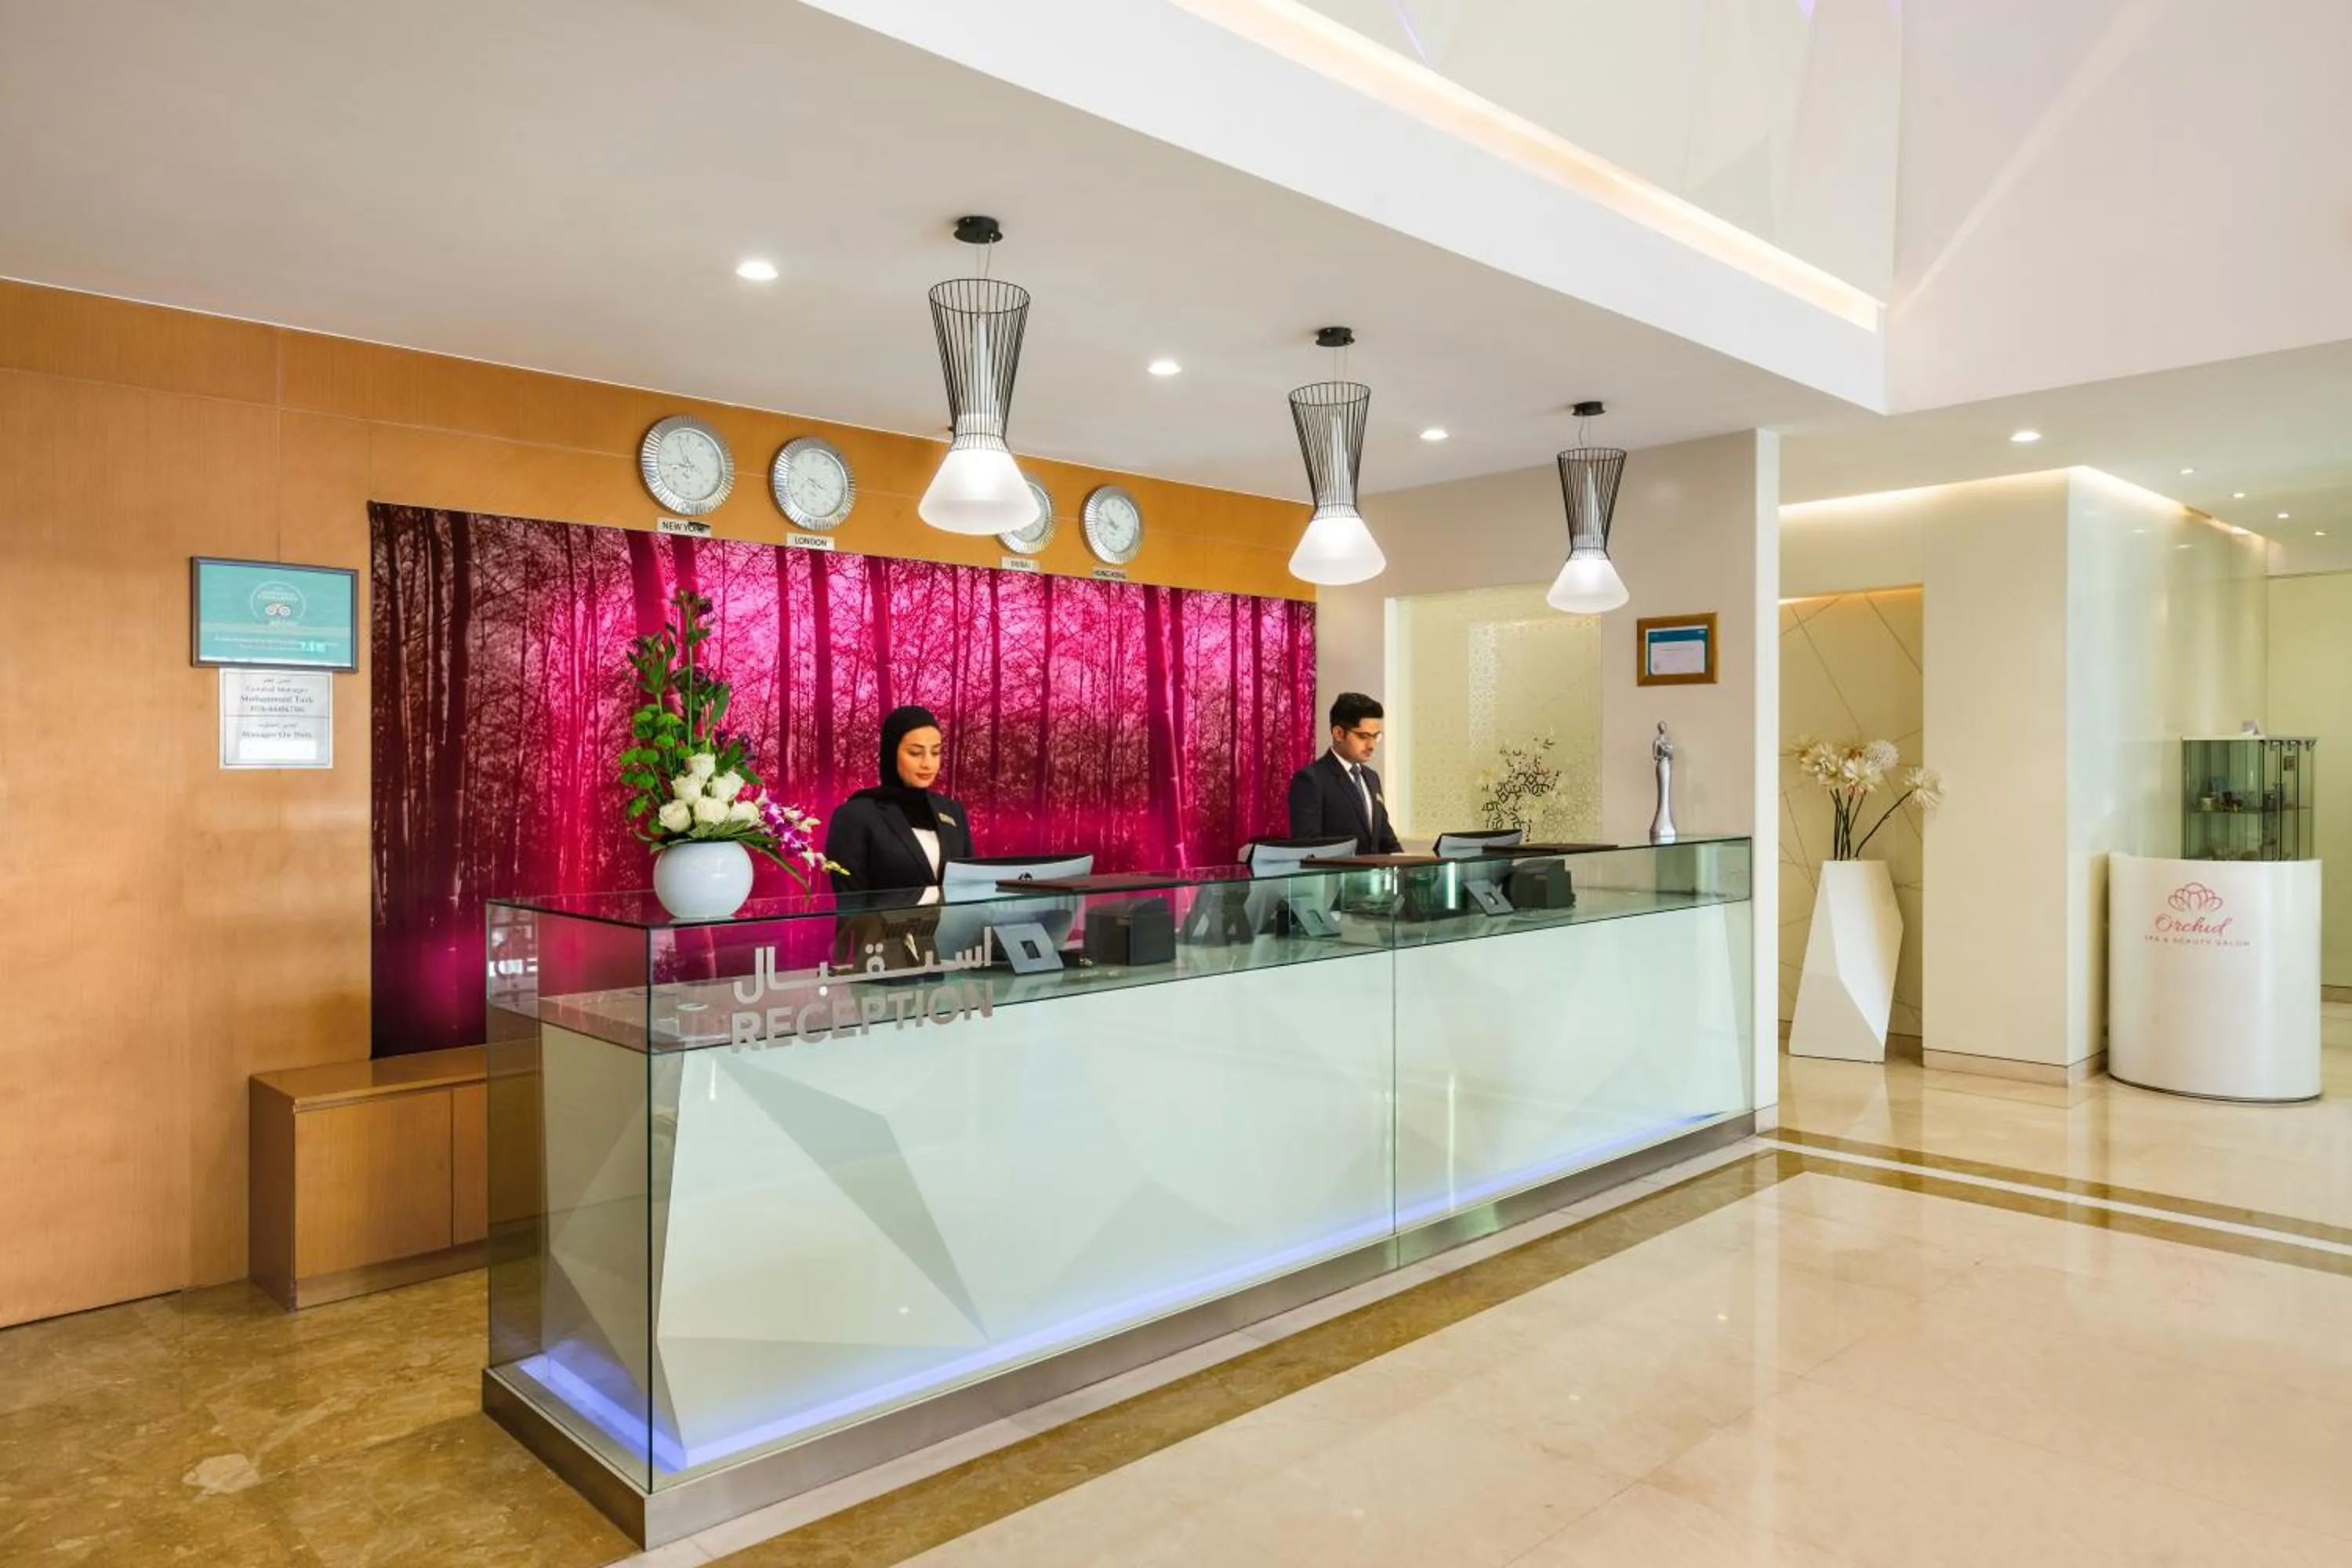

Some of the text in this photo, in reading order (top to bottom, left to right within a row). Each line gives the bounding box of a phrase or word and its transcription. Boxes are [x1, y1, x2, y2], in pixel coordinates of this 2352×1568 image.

[662, 520, 682, 531] NEW
[794, 536, 827, 546] LONDON
[2155, 913, 2233, 936] Orchid
[731, 979, 994, 1054] RECEPTION
